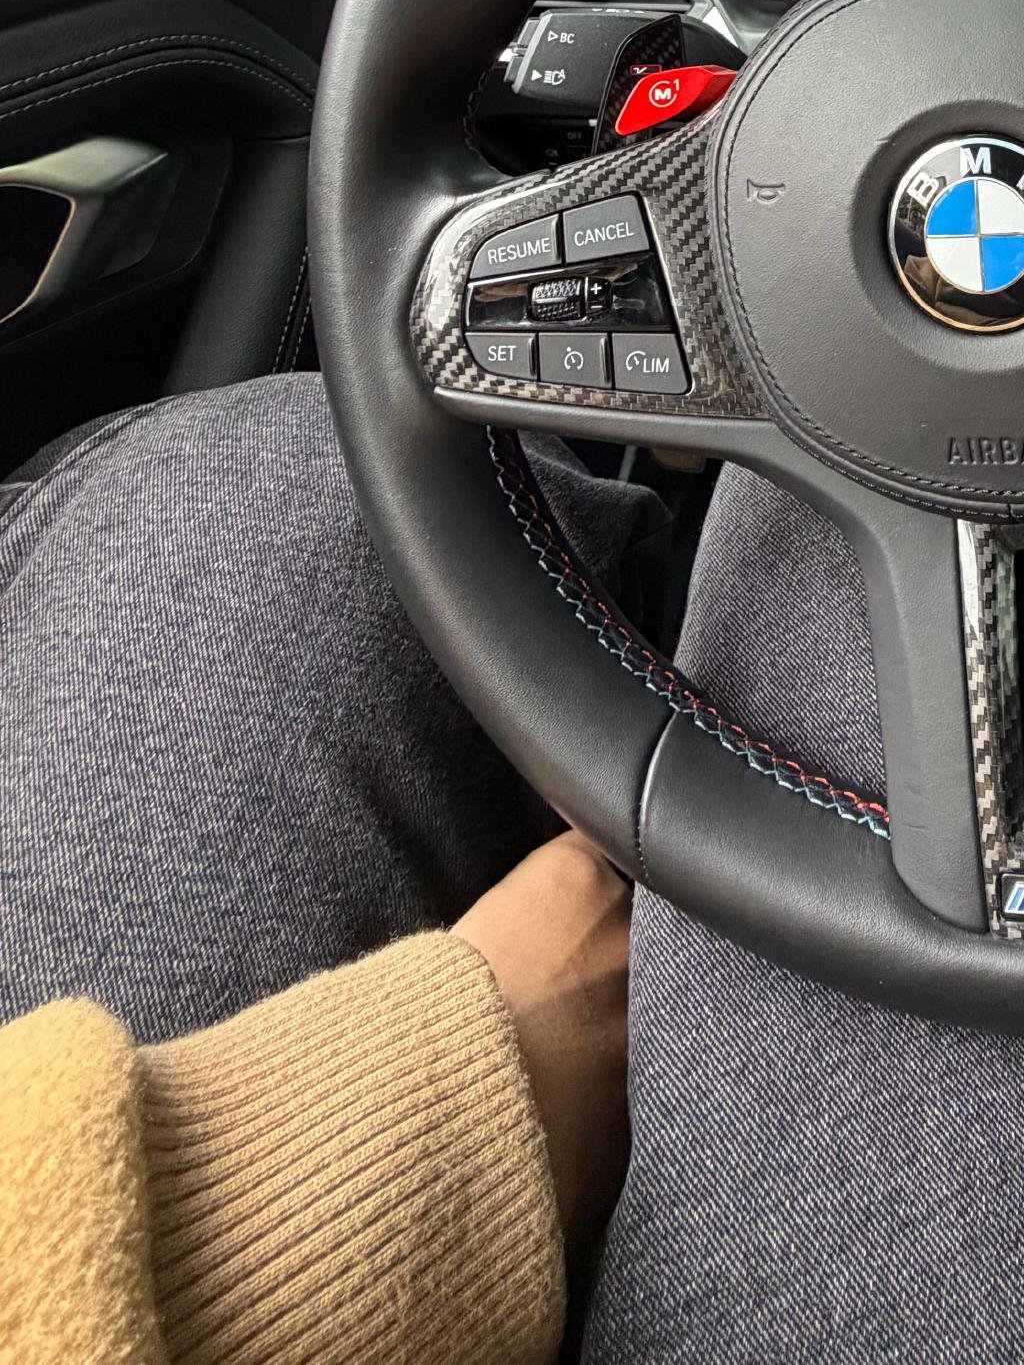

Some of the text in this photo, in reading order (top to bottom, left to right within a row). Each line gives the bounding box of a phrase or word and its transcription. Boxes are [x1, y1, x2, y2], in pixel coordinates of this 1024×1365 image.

[560, 32, 575, 44] BC
[573, 222, 635, 247] CANCEL
[487, 237, 551, 265] RESUME
[487, 345, 517, 362] SET
[642, 357, 670, 373] LIM
